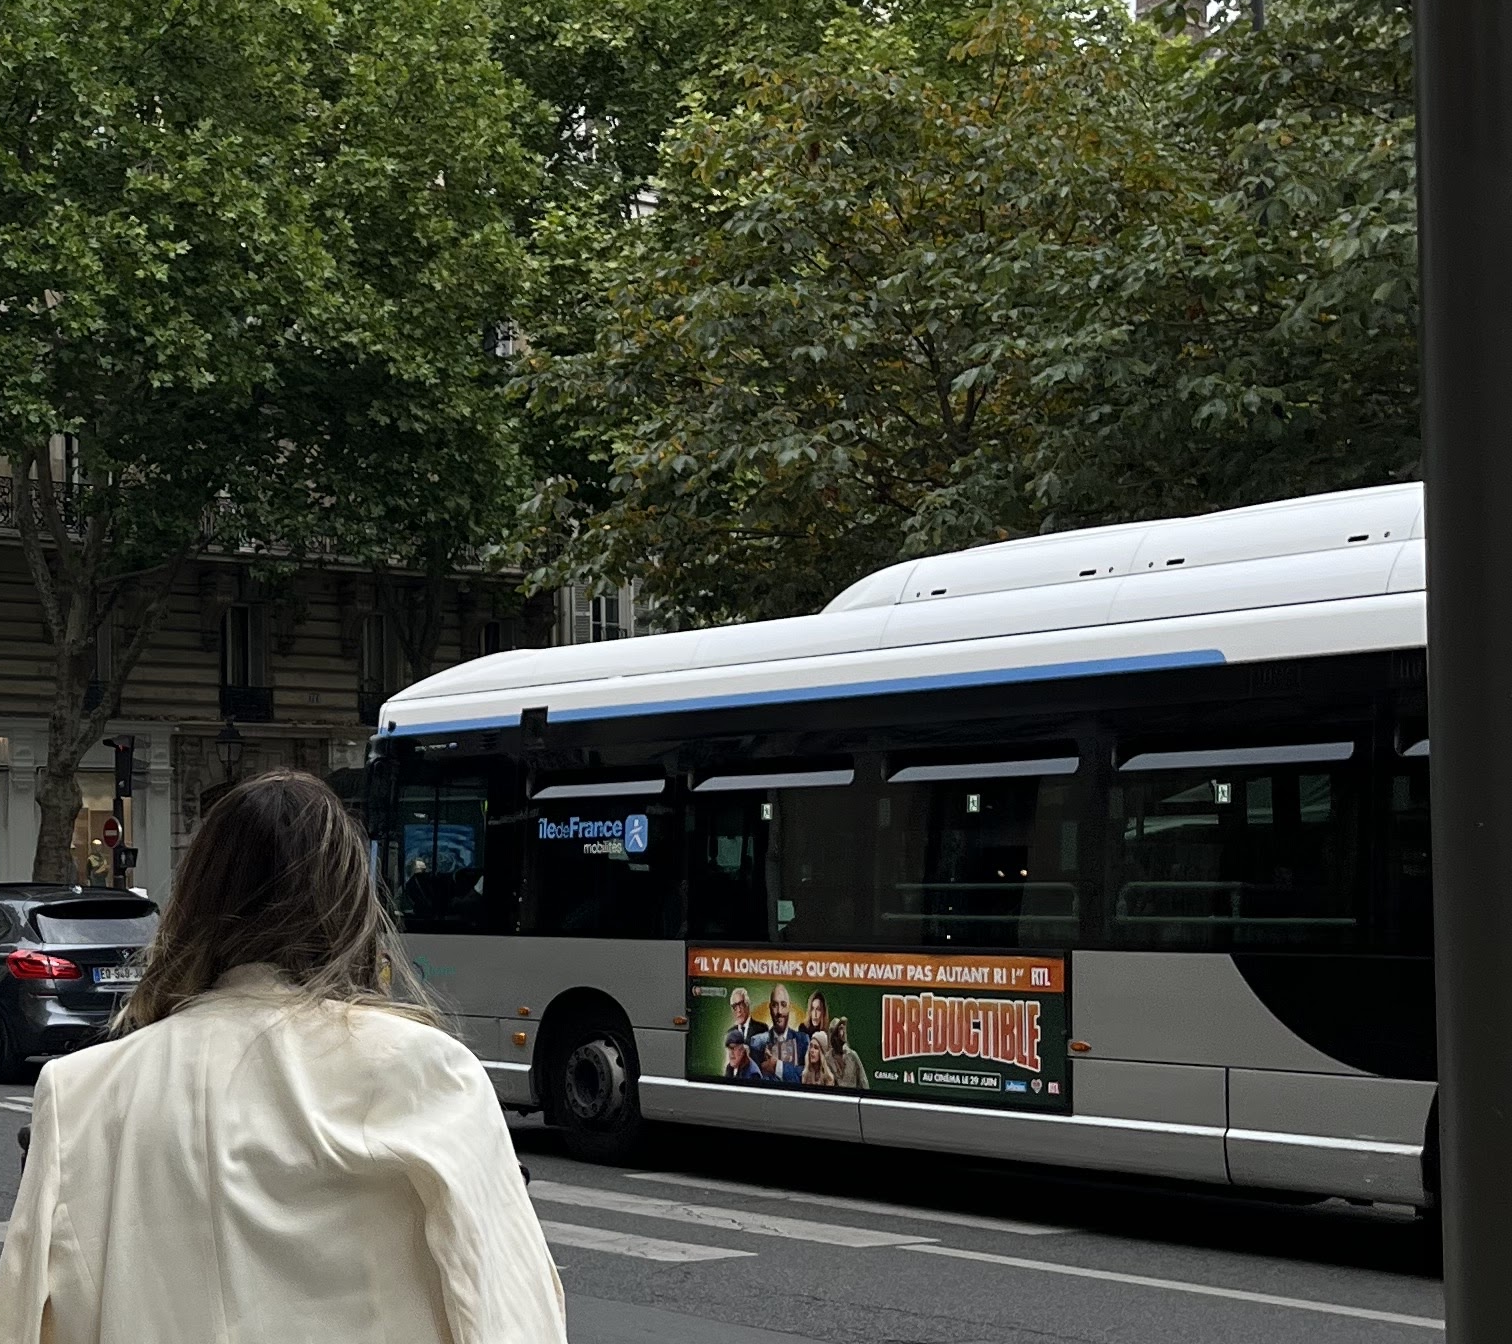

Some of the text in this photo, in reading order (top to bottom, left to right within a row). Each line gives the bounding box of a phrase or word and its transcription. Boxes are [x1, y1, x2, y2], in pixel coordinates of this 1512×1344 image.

[583, 838, 622, 854] mobilités
[712, 957, 720, 972] Y
[722, 958, 732, 973] A
[734, 958, 804, 976] LONGTEMPS
[906, 964, 933, 981] PAS
[936, 965, 990, 984] AUTANT
[993, 967, 1007, 984] RI
[1031, 967, 1051, 986] RTL
[882, 992, 1041, 1072] IRRÉDUCTIBLE
[922, 1072, 933, 1081] AU
[934, 1072, 960, 1084] CINÉMA
[961, 1074, 969, 1084] LE
[969, 1075, 979, 1085] 29
[980, 1076, 997, 1087] JUIN
